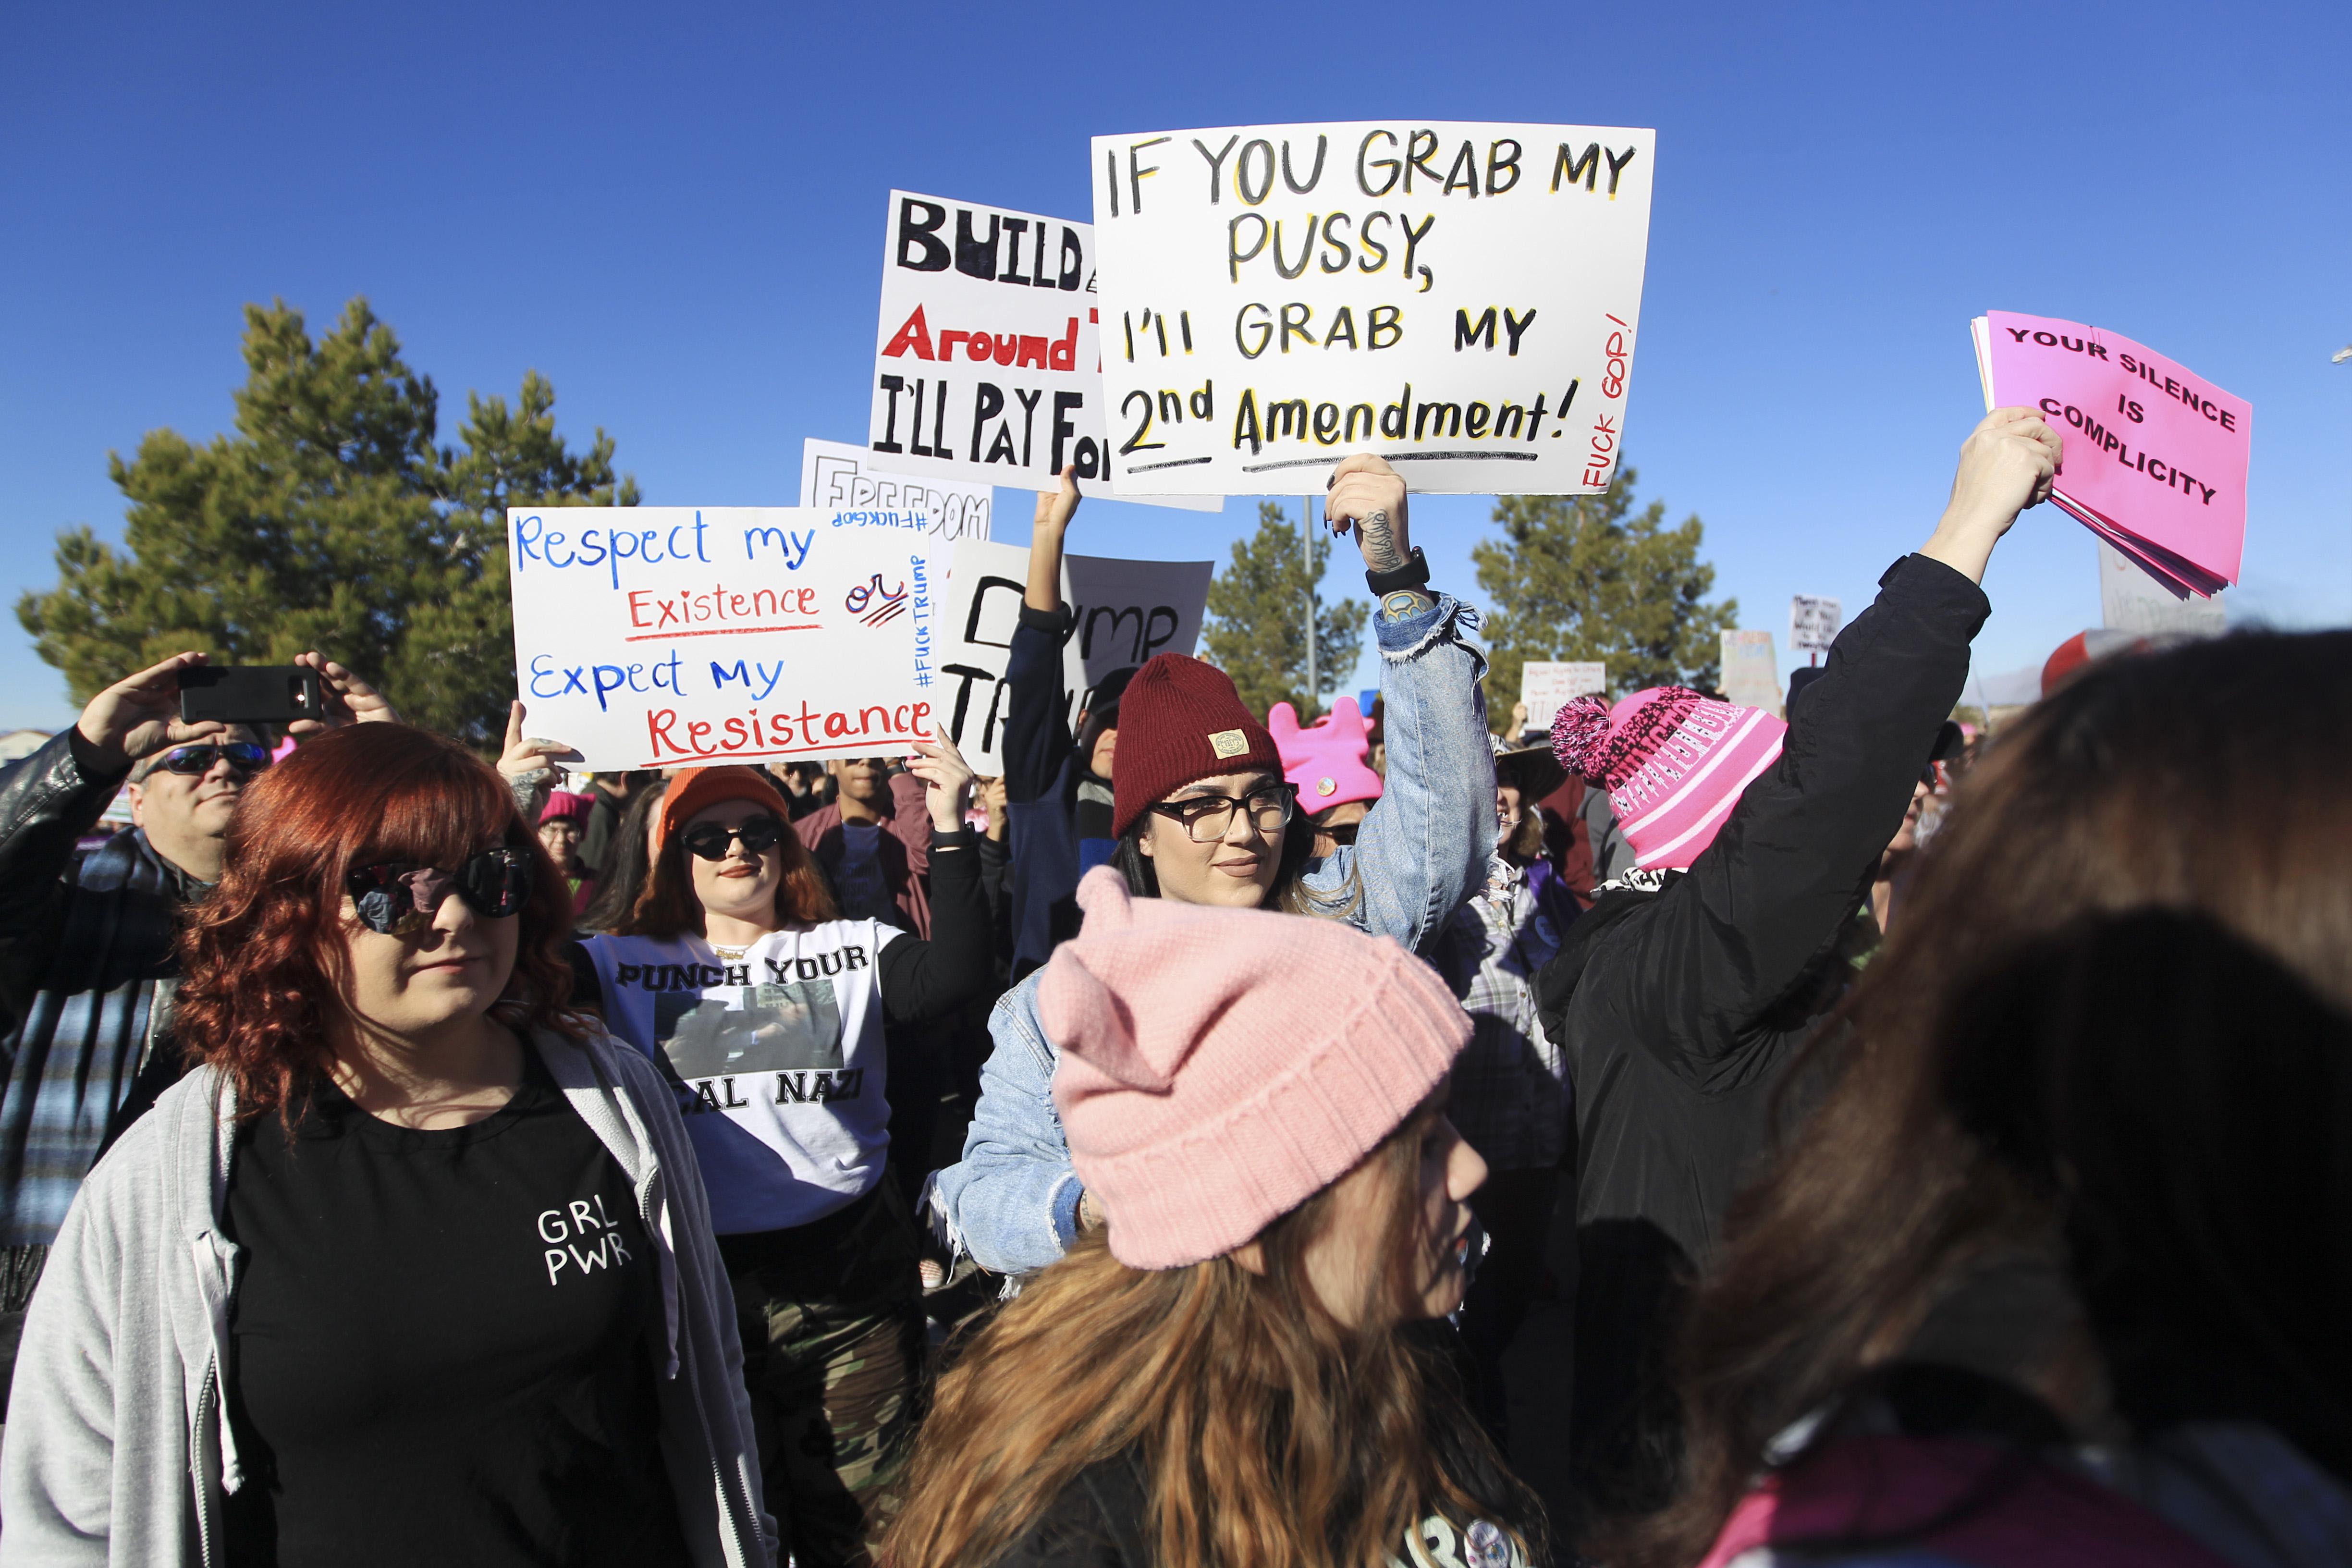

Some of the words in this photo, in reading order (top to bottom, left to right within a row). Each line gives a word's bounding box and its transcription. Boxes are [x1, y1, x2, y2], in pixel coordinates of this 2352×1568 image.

[1108, 137, 1171, 218] IF
[1190, 134, 1327, 206] YOU
[1356, 129, 1522, 199] GRAB
[1549, 142, 1636, 201] MY
[897, 197, 1082, 291] BUILD
[1228, 210, 1435, 293] PUSSY,
[882, 303, 1079, 371] Around
[1236, 303, 1404, 360] GRAB
[1455, 305, 1537, 357] MY
[1582, 414, 1616, 488] FUCK
[1602, 313, 1633, 399] GOP!
[2007, 327, 2109, 362] YOUR
[2119, 354, 2236, 433] SILENCE
[2118, 394, 2144, 423] IS
[873, 374, 953, 460] I'LL
[969, 382, 1042, 467] PAY
[1119, 379, 1213, 455] 2nd
[1232, 377, 1581, 454] Amendment!
[2039, 397, 2217, 506] COMPLICITY
[515, 510, 711, 590] Respect
[628, 584, 821, 629] Existence
[529, 649, 686, 712] Expect
[647, 700, 931, 758] Resistance
[615, 961, 752, 992] PUNCH
[764, 944, 869, 986] YOUR
[775, 1067, 864, 1105] NAZI
[538, 1194, 618, 1243] GRL
[544, 1232, 632, 1286] PWR
